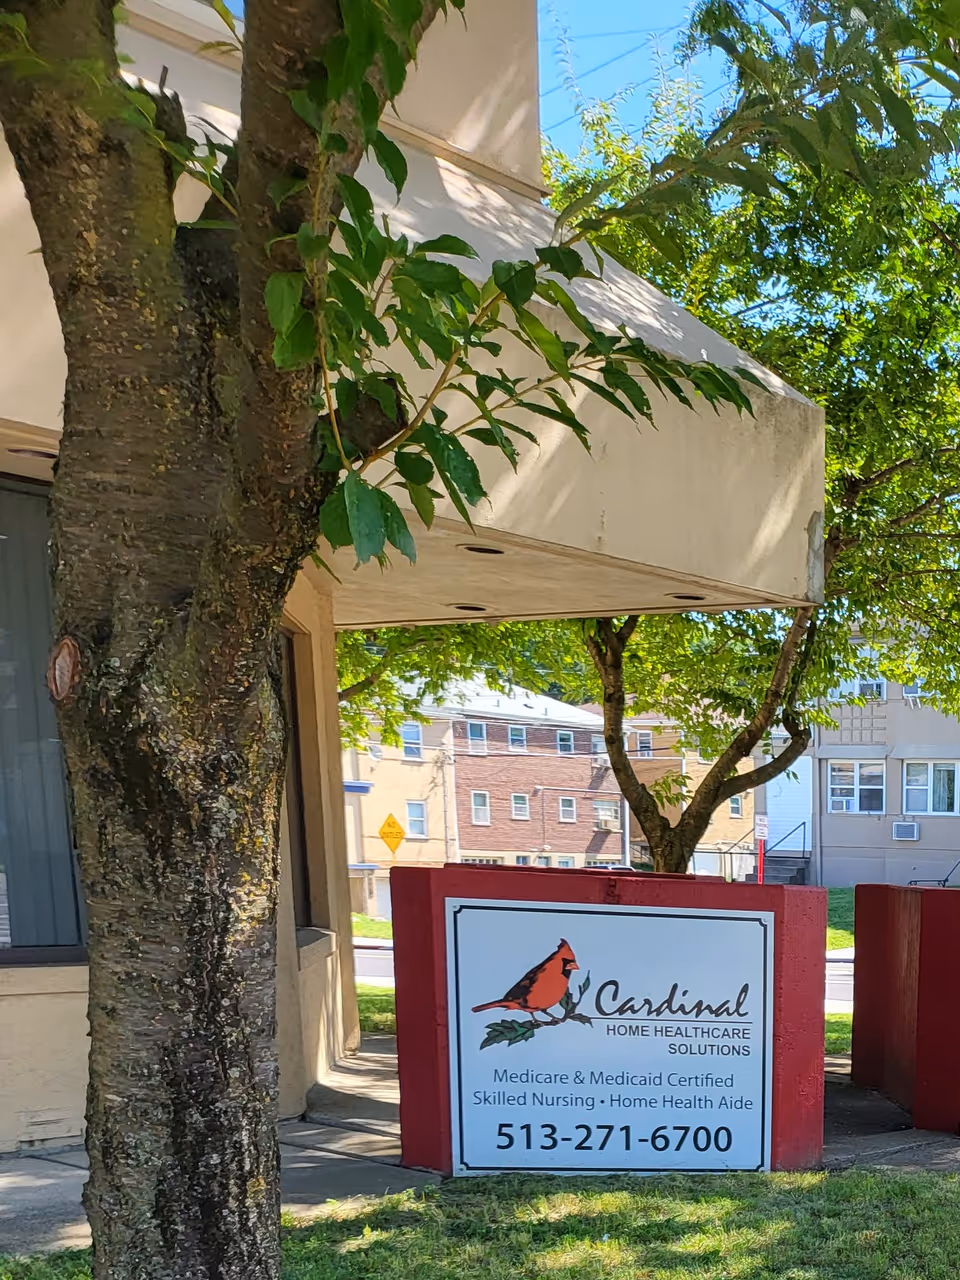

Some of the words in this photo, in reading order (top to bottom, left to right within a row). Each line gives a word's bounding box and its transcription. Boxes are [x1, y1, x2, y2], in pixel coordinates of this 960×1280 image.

[595, 979, 750, 1018] Cardinal
[606, 1024, 650, 1037] HOME
[654, 1025, 751, 1040] HEALTHCARE
[668, 1042, 751, 1057] SOLUTIONS
[493, 1068, 569, 1084] Medicare
[573, 1070, 585, 1084] &
[589, 1070, 662, 1086] Medicaid
[667, 1072, 734, 1088] Certified
[473, 1090, 527, 1106] Skilled
[532, 1092, 595, 1111] Nursing
[610, 1093, 658, 1108] Home
[662, 1094, 713, 1109] Health
[718, 1096, 753, 1110] Aide
[496, 1123, 733, 1152] 513-271-6700
